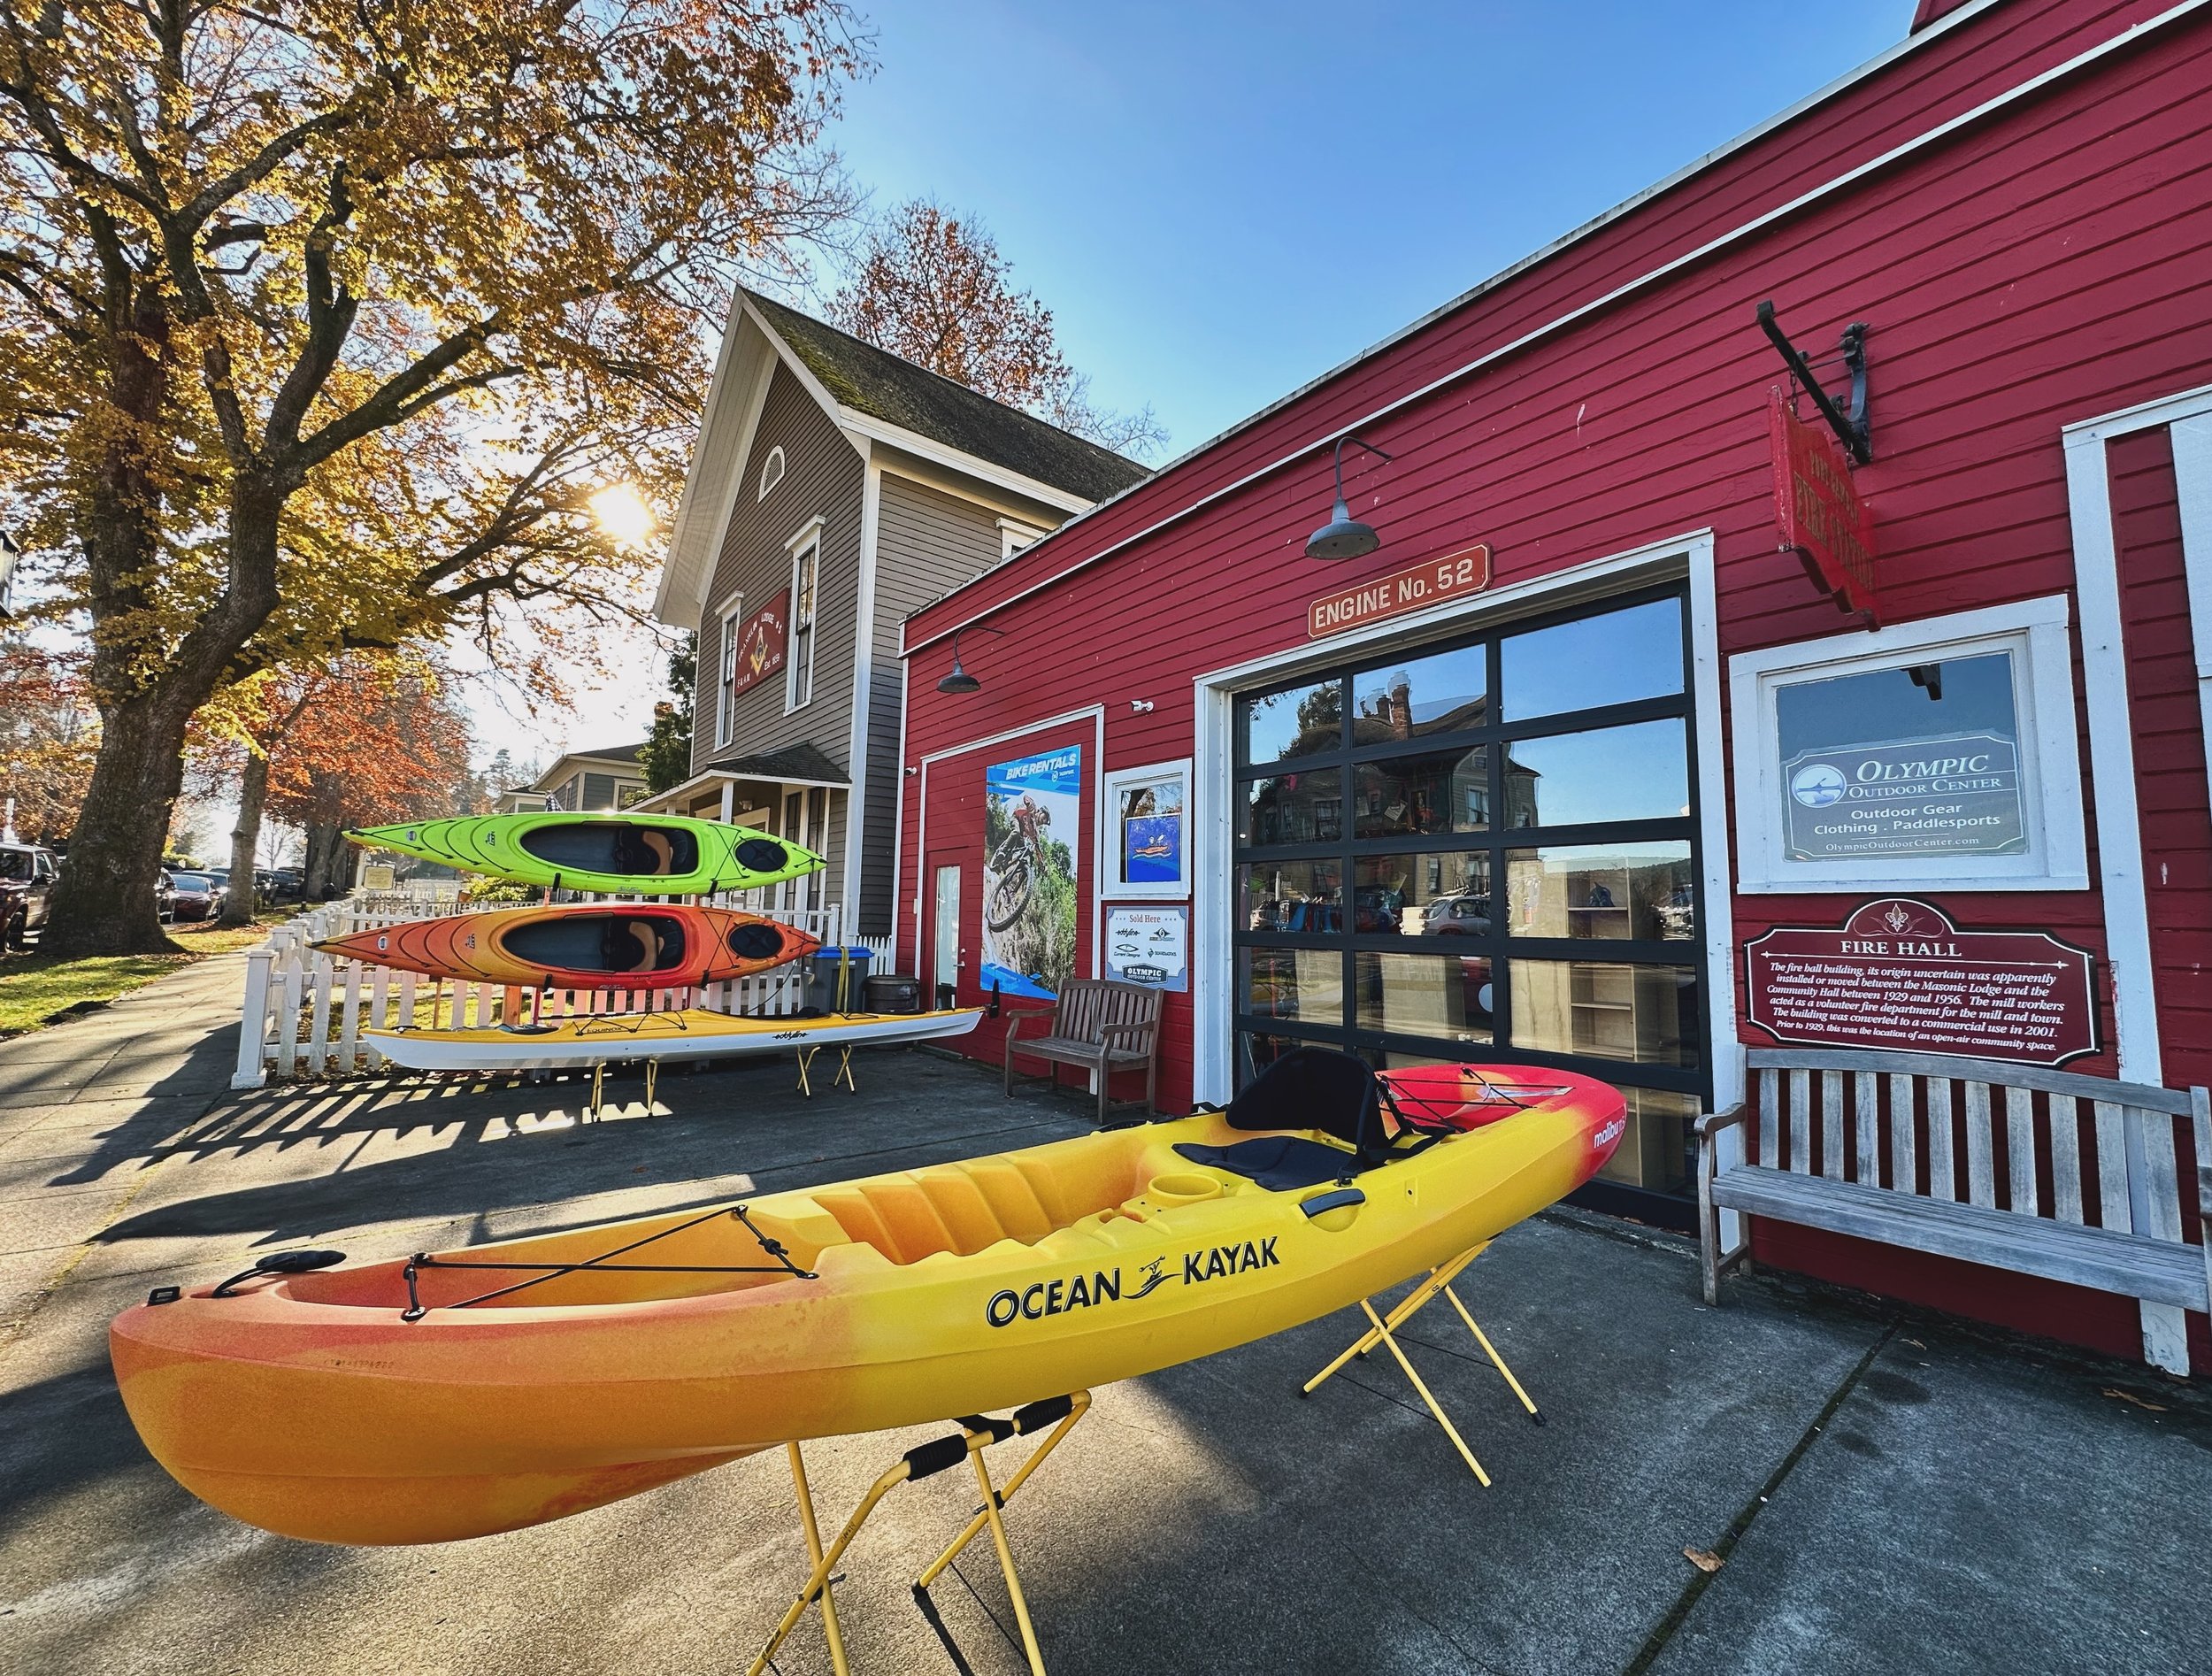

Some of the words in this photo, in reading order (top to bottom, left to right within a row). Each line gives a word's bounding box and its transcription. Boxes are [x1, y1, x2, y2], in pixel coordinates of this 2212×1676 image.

[1315, 584, 1391, 629] ENGINE
[1398, 577, 1432, 604] No.
[1437, 558, 1473, 590] 52
[738, 619, 757, 663] FRANKLIN
[761, 612, 774, 624] LODGE
[1006, 765, 1029, 780] BIKE
[1029, 753, 1076, 775] RENTALS
[1856, 754, 1989, 782] OLYMPIC
[1849, 784, 1926, 799] OUTDOOR
[1932, 777, 2001, 793] CENTER
[1851, 807, 1917, 819] Outdoor
[1923, 804, 1962, 815] Gear
[1814, 823, 1878, 835] Clothing
[1893, 815, 2001, 831] Paddlesports
[1825, 838, 1980, 852] OlympicOutdoorCenter.com
[1129, 914, 1144, 923] Sold
[1145, 915, 1161, 923] Here
[1840, 941, 1889, 954] FIRE
[1897, 942, 1962, 957] HALL
[1127, 967, 1161, 977] OLYMPIC
[1770, 962, 1786, 971] The
[1787, 964, 1802, 973] fire
[1804, 964, 1822, 972] hall
[1824, 965, 1864, 977] building,
[1867, 966, 1879, 975] its
[1881, 968, 1911, 978] origin
[1914, 970, 1965, 979] uncertain
[1968, 972, 1990, 980] was
[1993, 973, 2056, 986] apparently
[1767, 985, 1817, 997] Community
[1819, 988, 1839, 997] Hall
[1841, 989, 1880, 999] between
[1883, 991, 1908, 1002] 1929
[1910, 993, 1931, 1003] and
[1934, 995, 1962, 1005] 1956.
[1970, 996, 1989, 1006] The
[1991, 998, 2014, 1008] mill
[2017, 1000, 2065, 1011] workers
[1776, 974, 1814, 984] installed
[1828, 977, 1858, 986] moved
[1861, 978, 1901, 988] between
[1904, 980, 1919, 990] the
[1921, 982, 1967, 992] Masonic
[1969, 984, 2002, 996] Lodge
[2004, 986, 2028, 996] and
[2031, 987, 2049, 997] the
[1770, 997, 1793, 1005] acted
[1816, 999, 1860, 1010] volunteer
[1860, 1002, 1878, 1013] fire
[1880, 1003, 1939, 1015] department
[1940, 1007, 1957, 1019] for
[1959, 1009, 1976, 1018] the
[1979, 1010, 2002, 1020] mill
[2004, 1012, 2027, 1022] and
[2030, 1014, 2063, 1024] town.
[1774, 1007, 1788, 1016] The
[1790, 1008, 1828, 1021] building
[1850, 1014, 1897, 1025] converted
[1900, 1018, 1910, 1026] to
[1922, 1019, 1985, 1032] commercial
[1988, 1025, 2007, 1033] use
[2010, 1026, 2022, 1034] in
[2024, 1026, 2058, 1038] 2001.
[1805, 1023, 1825, 1032] 1929,
[1859, 1027, 1872, 1035] the
[1873, 1028, 1906, 1038] location
[1908, 1031, 1918, 1041] of
[1932, 1034, 1970, 1043] open-air
[1971, 1037, 2025, 1049] community
[2026, 1042, 2056, 1051] space.
[1594, 1121, 1619, 1148] malibu
[986, 1267, 1120, 1328] OCEAN
[1183, 1236, 1280, 1285] KAYAK
